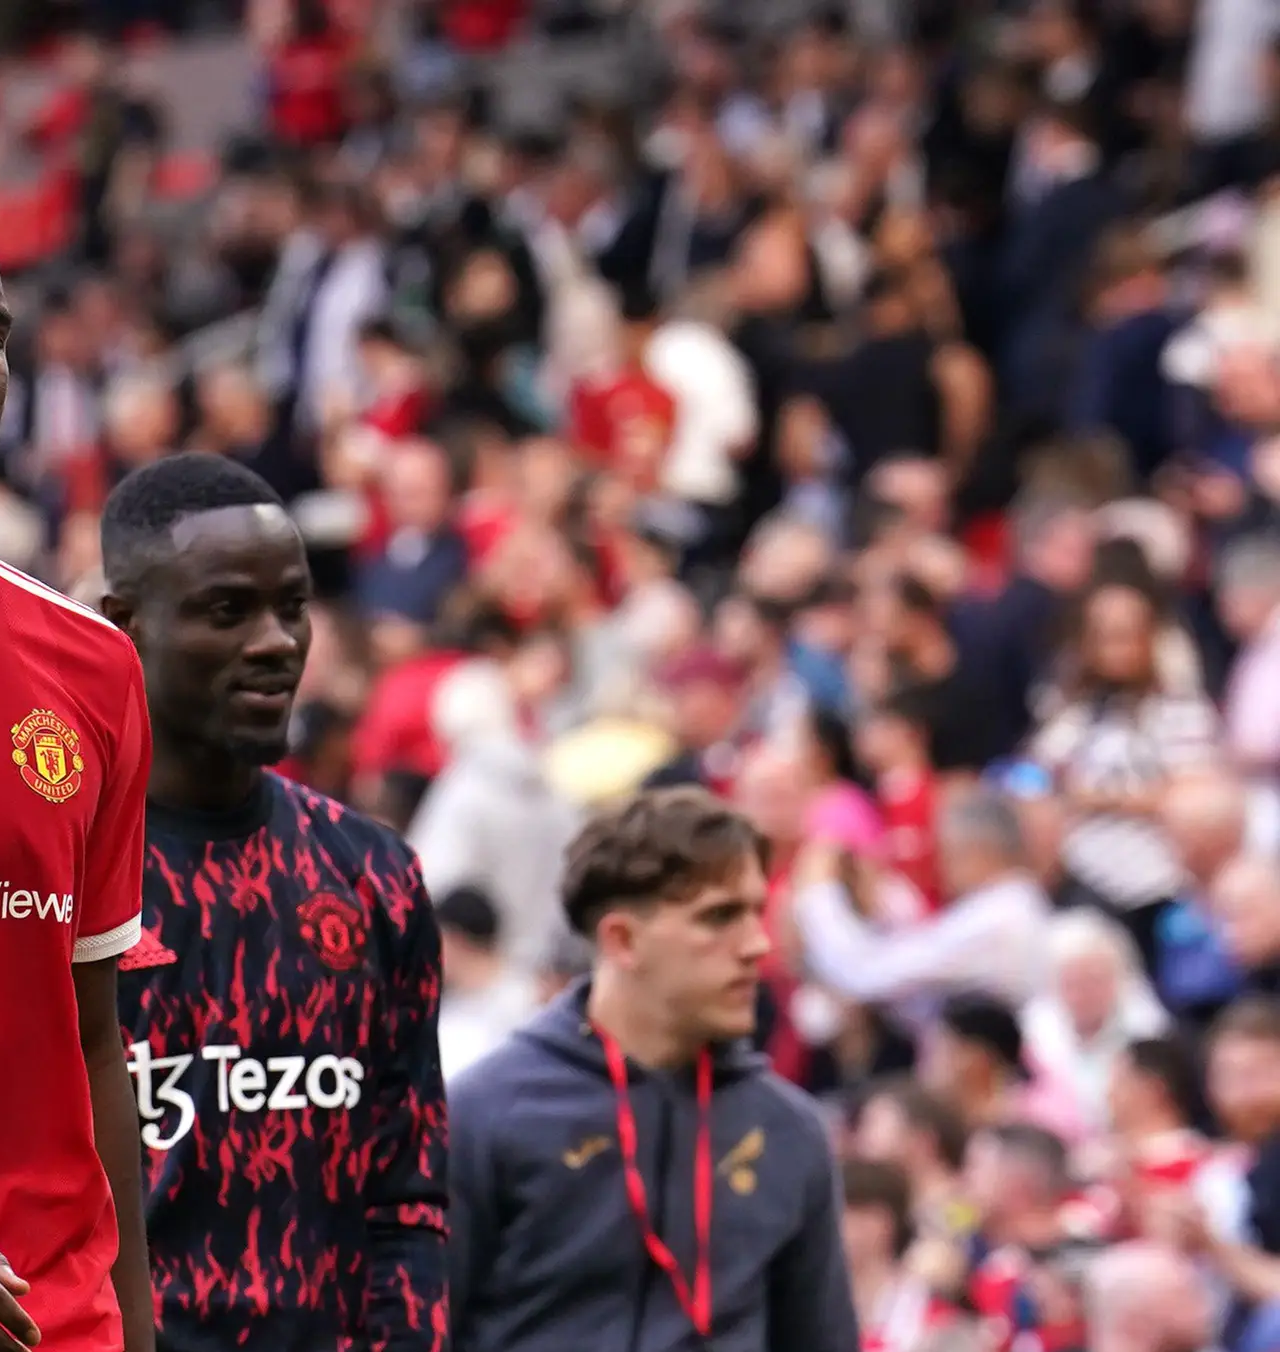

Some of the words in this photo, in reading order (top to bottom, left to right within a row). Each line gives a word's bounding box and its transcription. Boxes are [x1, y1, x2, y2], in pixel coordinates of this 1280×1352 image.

[17, 715, 76, 748] MANCHESTER
[34, 778, 74, 796] UNITED
[201, 1044, 365, 1113] Tezos
